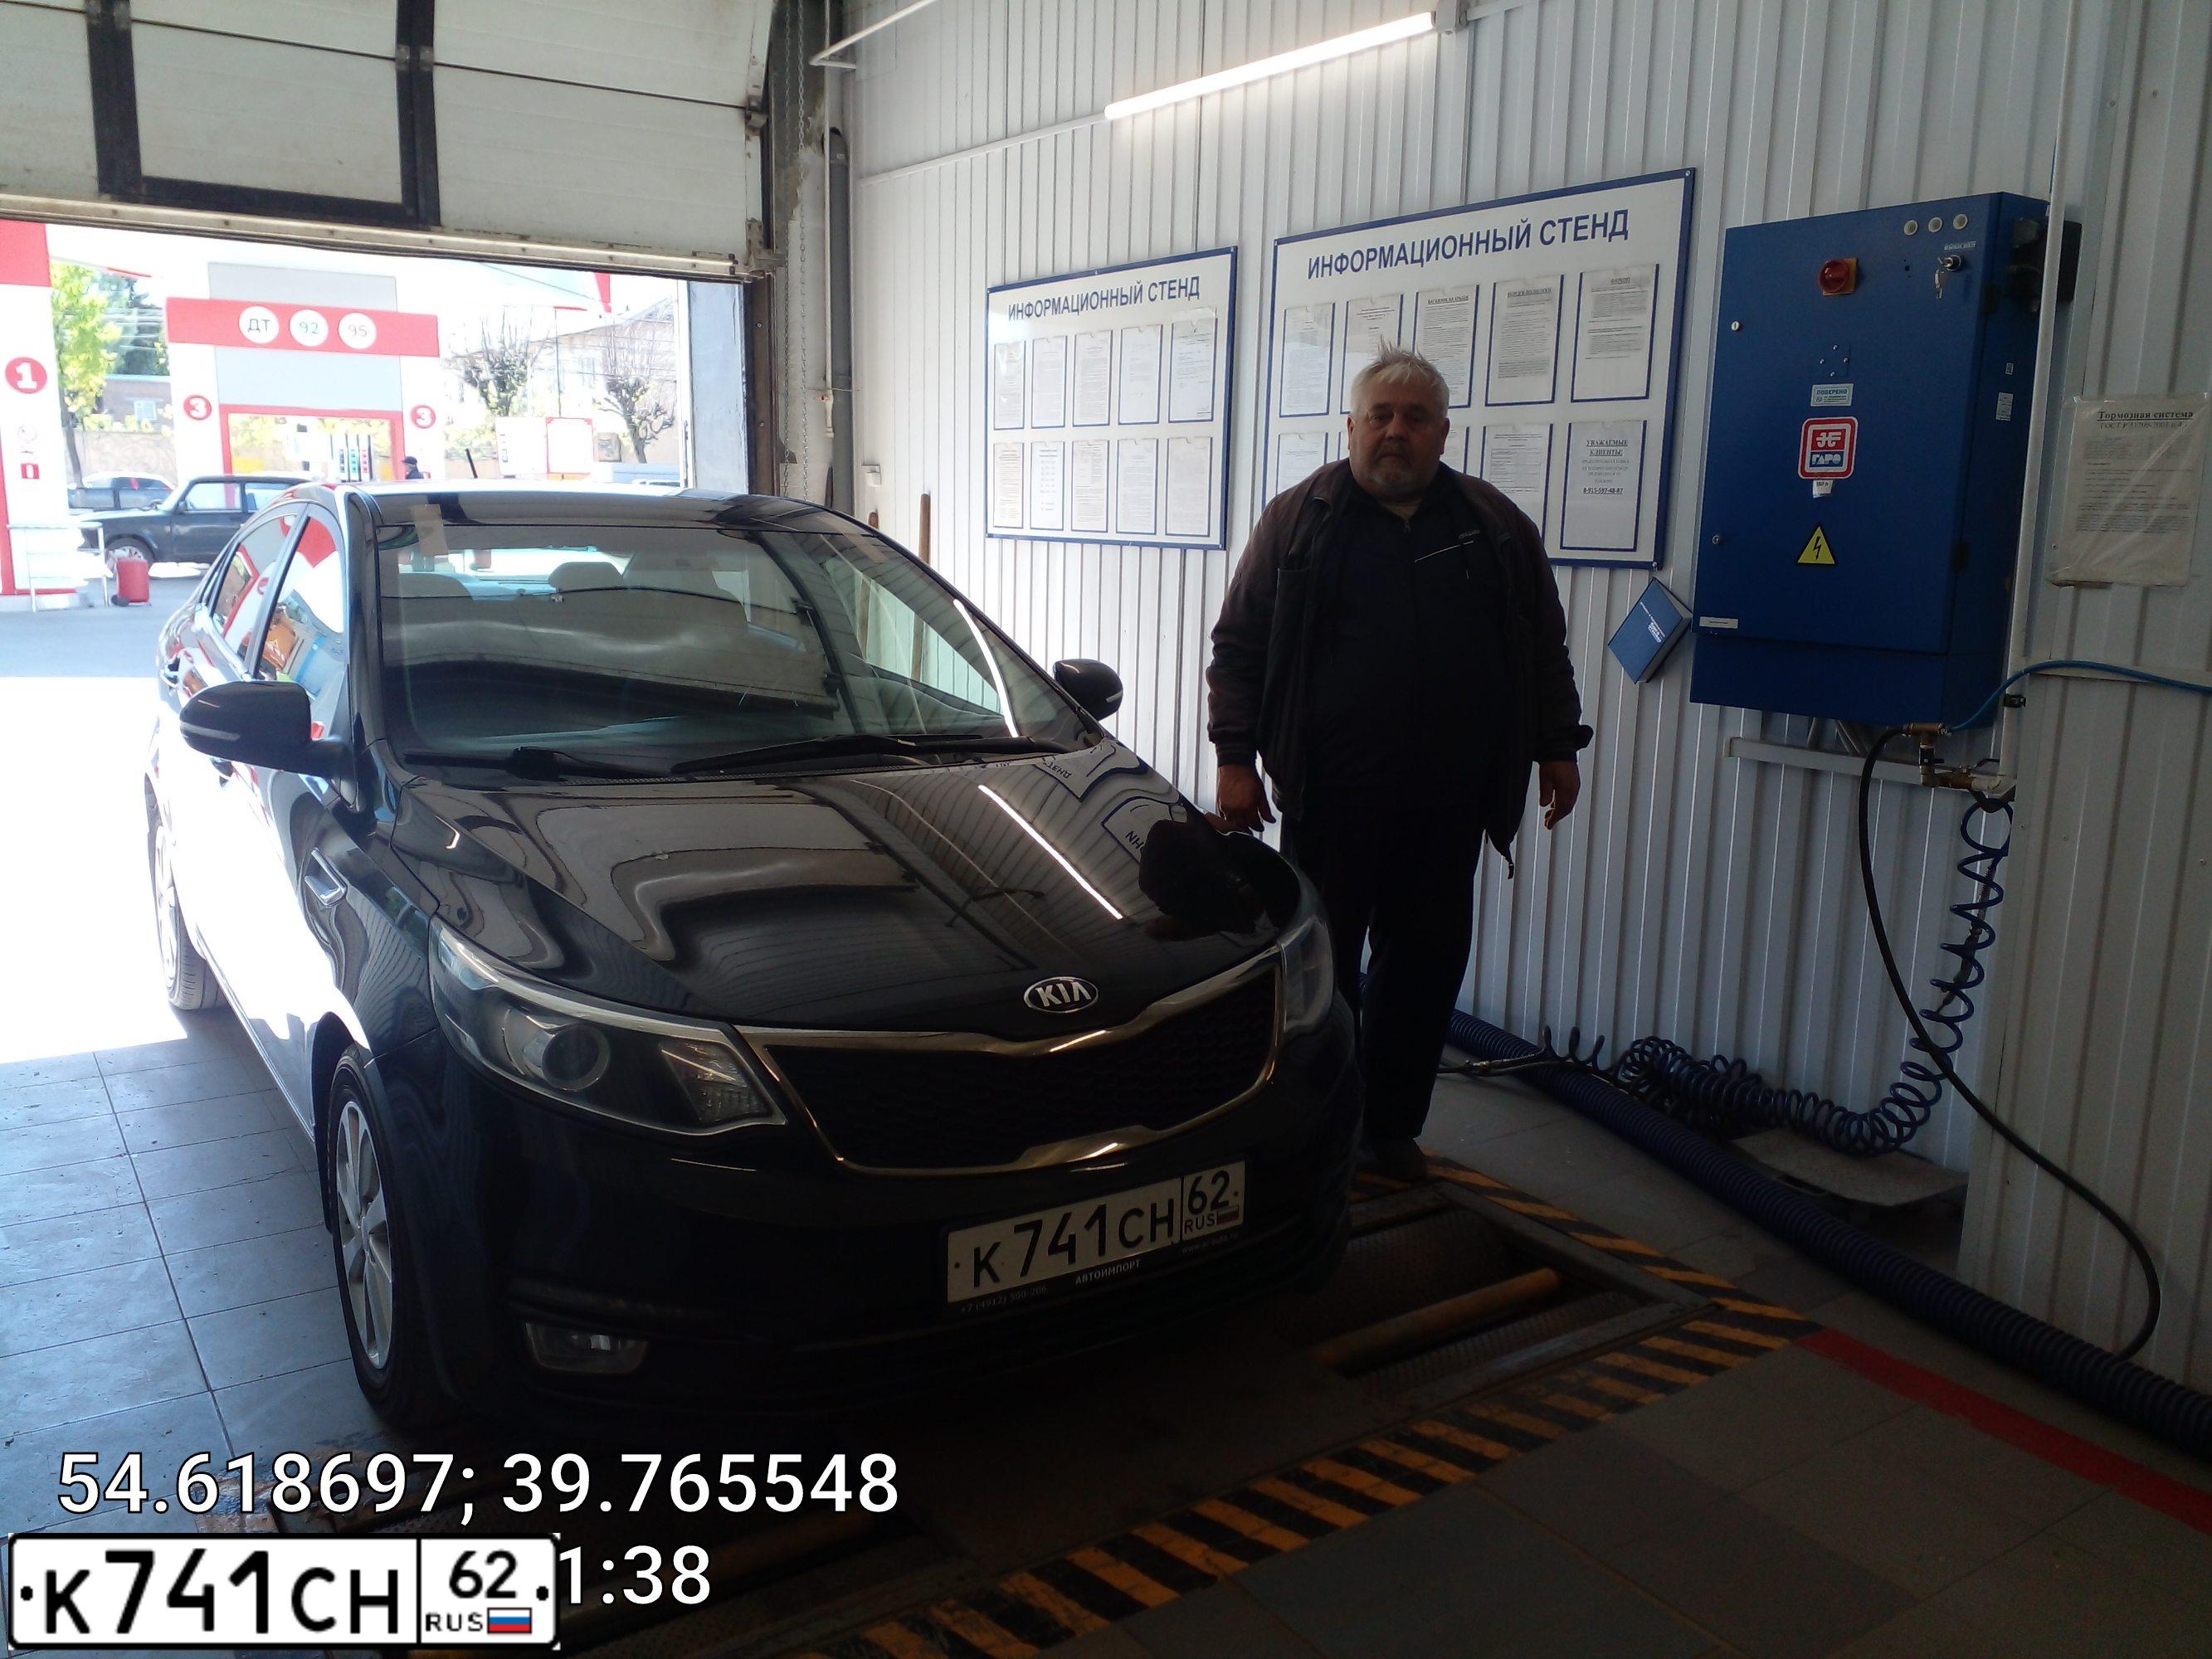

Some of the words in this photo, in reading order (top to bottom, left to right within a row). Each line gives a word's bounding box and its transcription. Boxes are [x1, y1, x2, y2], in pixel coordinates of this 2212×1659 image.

[1307, 217, 1532, 280] ИНФОРМАЦИОННЫЙ
[1539, 208, 1630, 247] СТЕНД
[1007, 280, 1144, 322] ИНФОРМАЦИОННЫЙ
[1148, 275, 1201, 302] СТЕНД
[247, 319, 270, 333] ДТ
[299, 320, 319, 335] 92
[348, 324, 368, 338] 95
[16, 362, 37, 390] 1
[189, 397, 207, 420] 3
[416, 406, 431, 426] 3
[2097, 411, 2151, 421] Тормозная
[2153, 411, 2194, 419] система
[1810, 453, 1842, 465] ГАРО
[1035, 981, 1093, 1008] KIA
[1187, 1170, 1230, 1214] 62
[1183, 1214, 1216, 1234] RUS
[1075, 1258, 1142, 1286] АВТОИМПОРТ
